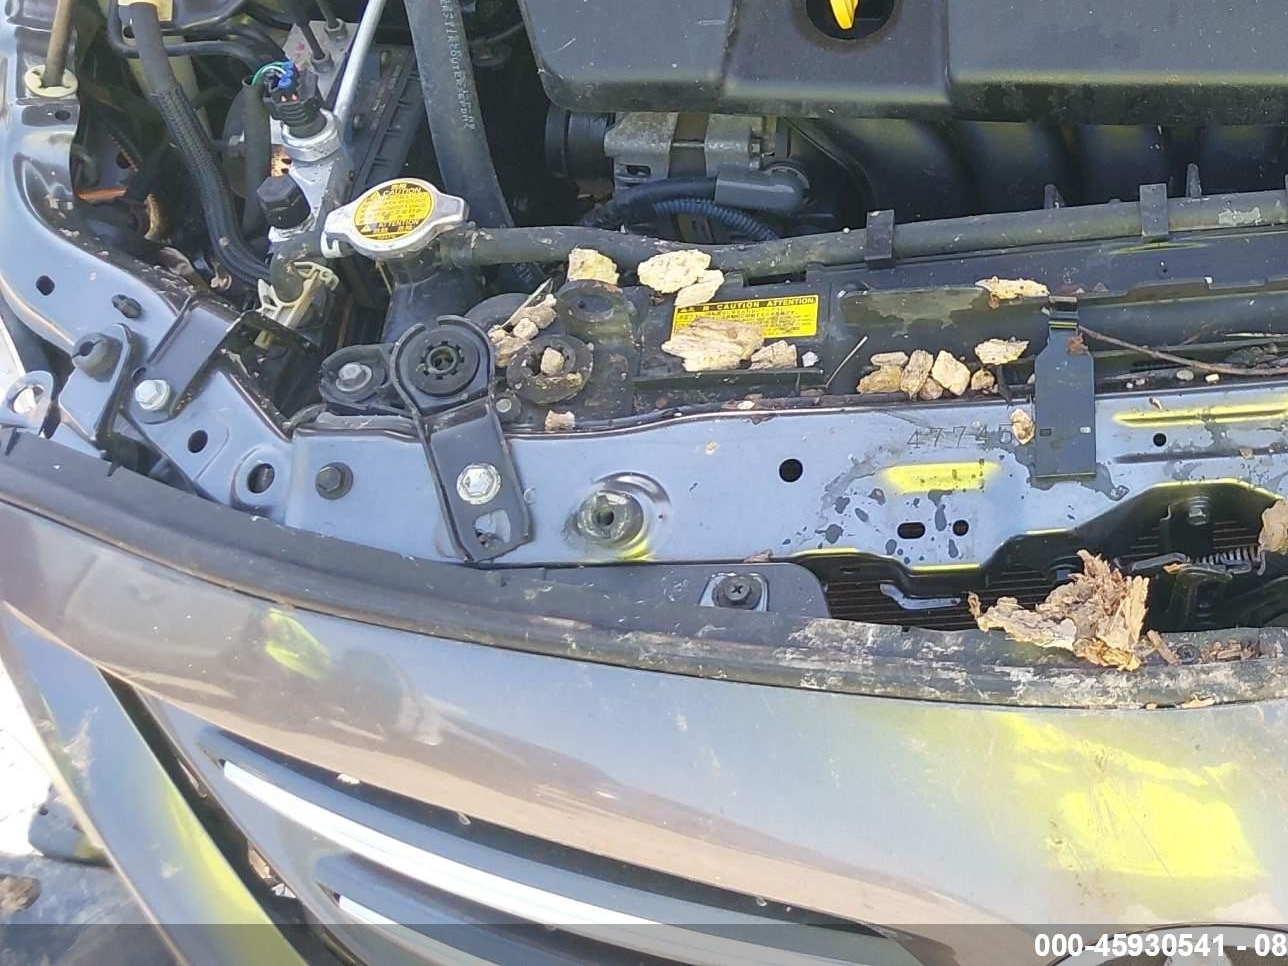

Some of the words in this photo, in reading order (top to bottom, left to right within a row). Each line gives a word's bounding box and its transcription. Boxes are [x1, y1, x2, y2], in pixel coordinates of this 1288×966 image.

[383, 187, 421, 197] CAUTION
[716, 301, 760, 310] CAUTION
[766, 297, 815, 307] ATTENTION
